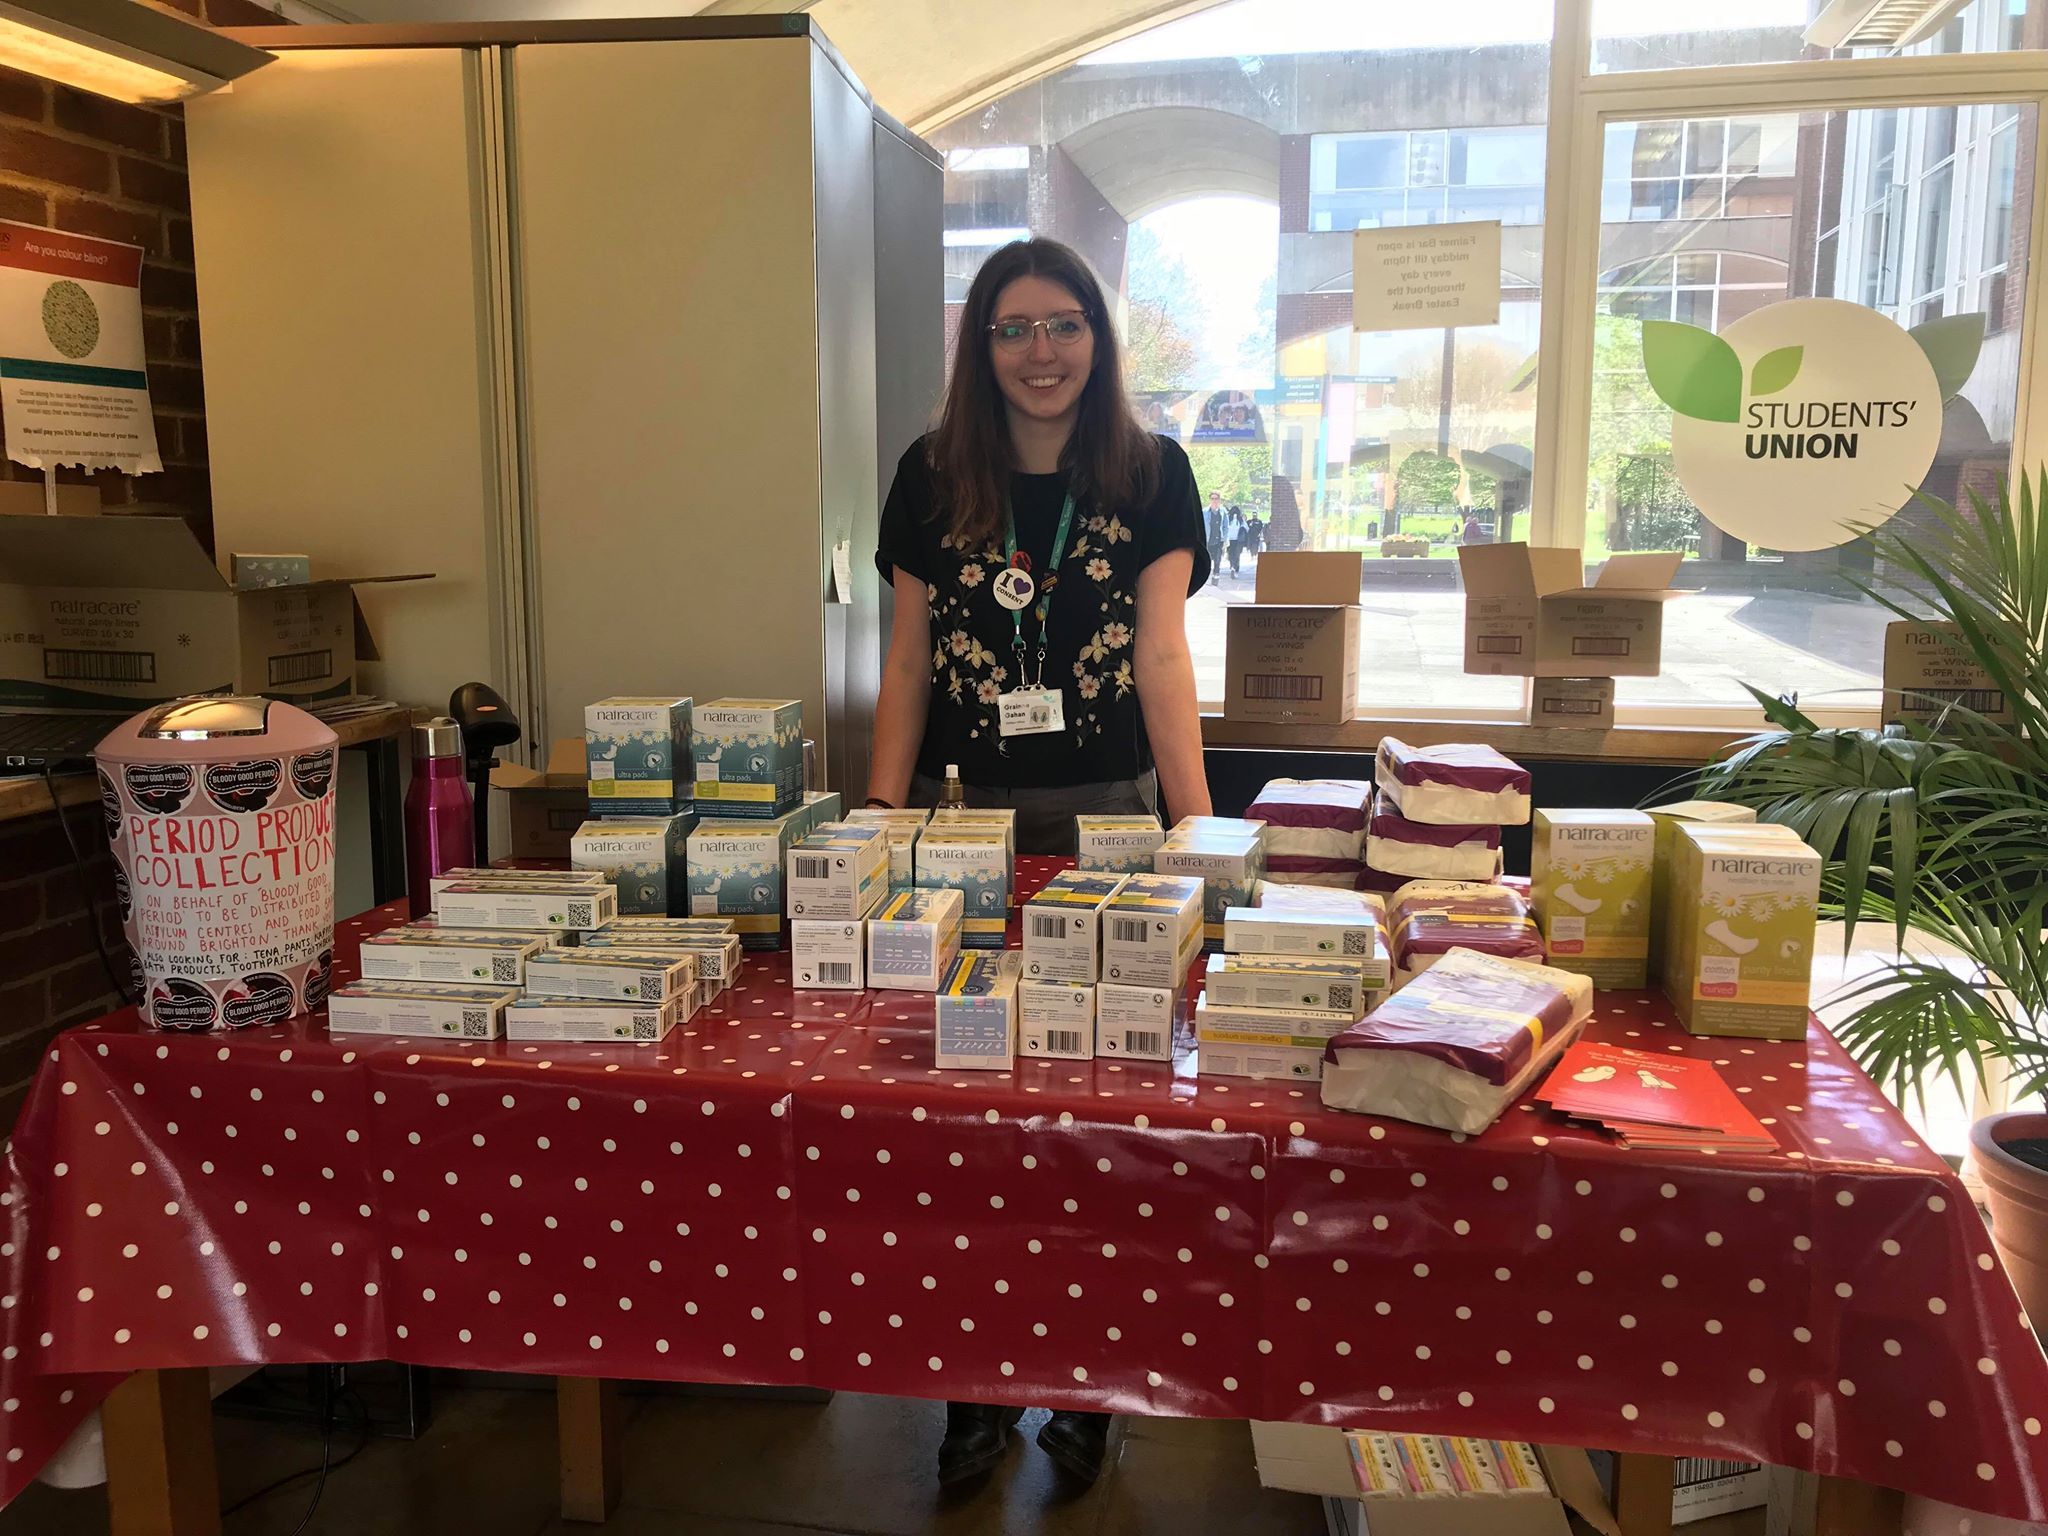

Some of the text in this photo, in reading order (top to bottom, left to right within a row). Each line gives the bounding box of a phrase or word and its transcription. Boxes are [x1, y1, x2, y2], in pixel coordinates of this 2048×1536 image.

[24, 242, 39, 254] Are
[42, 246, 56, 256] you
[58, 248, 82, 261] colour
[1748, 400, 1917, 428] STUDENTS'
[1746, 434, 1858, 459] UNION
[1000, 572, 1013, 588] I
[997, 587, 1023, 605] CONSENT
[50, 600, 137, 616] natracare
[1247, 616, 1323, 629] natracare
[62, 628, 97, 638] CURVED
[122, 630, 134, 639] 30
[1258, 656, 1280, 664] LONG
[1922, 668, 1952, 678] SUPER
[1958, 670, 1966, 678] 12
[597, 711, 657, 721] natracare
[704, 712, 762, 724] natracare
[150, 773, 164, 782] GOOD
[165, 772, 186, 782] PERIOD
[213, 769, 276, 784] BLOODY GOOD PERIOD
[632, 772, 648, 780] pads
[737, 774, 752, 782] pads
[130, 816, 239, 854] PERIOD
[1092, 836, 1152, 847] natracare
[1558, 828, 1647, 842] natracare
[585, 841, 652, 852] natracare
[700, 841, 766, 852] natracare
[930, 849, 992, 860] natracare
[136, 836, 334, 891] COLLECTION
[1166, 856, 1231, 869] natracare
[1712, 859, 1812, 876] natracare
[147, 896, 161, 908] ON
[174, 895, 223, 910] BEHALF
[234, 892, 248, 906] OF
[308, 873, 327, 891] GOOD
[196, 910, 211, 922] TO
[222, 908, 240, 922] BE
[250, 890, 321, 917] DISTRIBUTED
[738, 906, 754, 914] pads
[198, 924, 253, 940] CENTRES
[266, 916, 289, 930] AND
[299, 904, 320, 922] FOOD
[142, 937, 185, 952] AROUND
[200, 934, 269, 952] BRIGHTON
[284, 922, 318, 940] THANK
[147, 952, 164, 962] ALSO
[169, 954, 214, 964] LOOKING
[220, 953, 239, 964] FOR
[254, 948, 279, 960] TENA
[172, 962, 224, 976] PRODUCTS,
[230, 954, 298, 972] TOOTHPASTE,
[1704, 966, 1736, 976] cotton
[1703, 986, 1734, 994] curved
[190, 1006, 210, 1015] PERIOD
[230, 996, 289, 1017] BLOODY GOOD PERIOD
